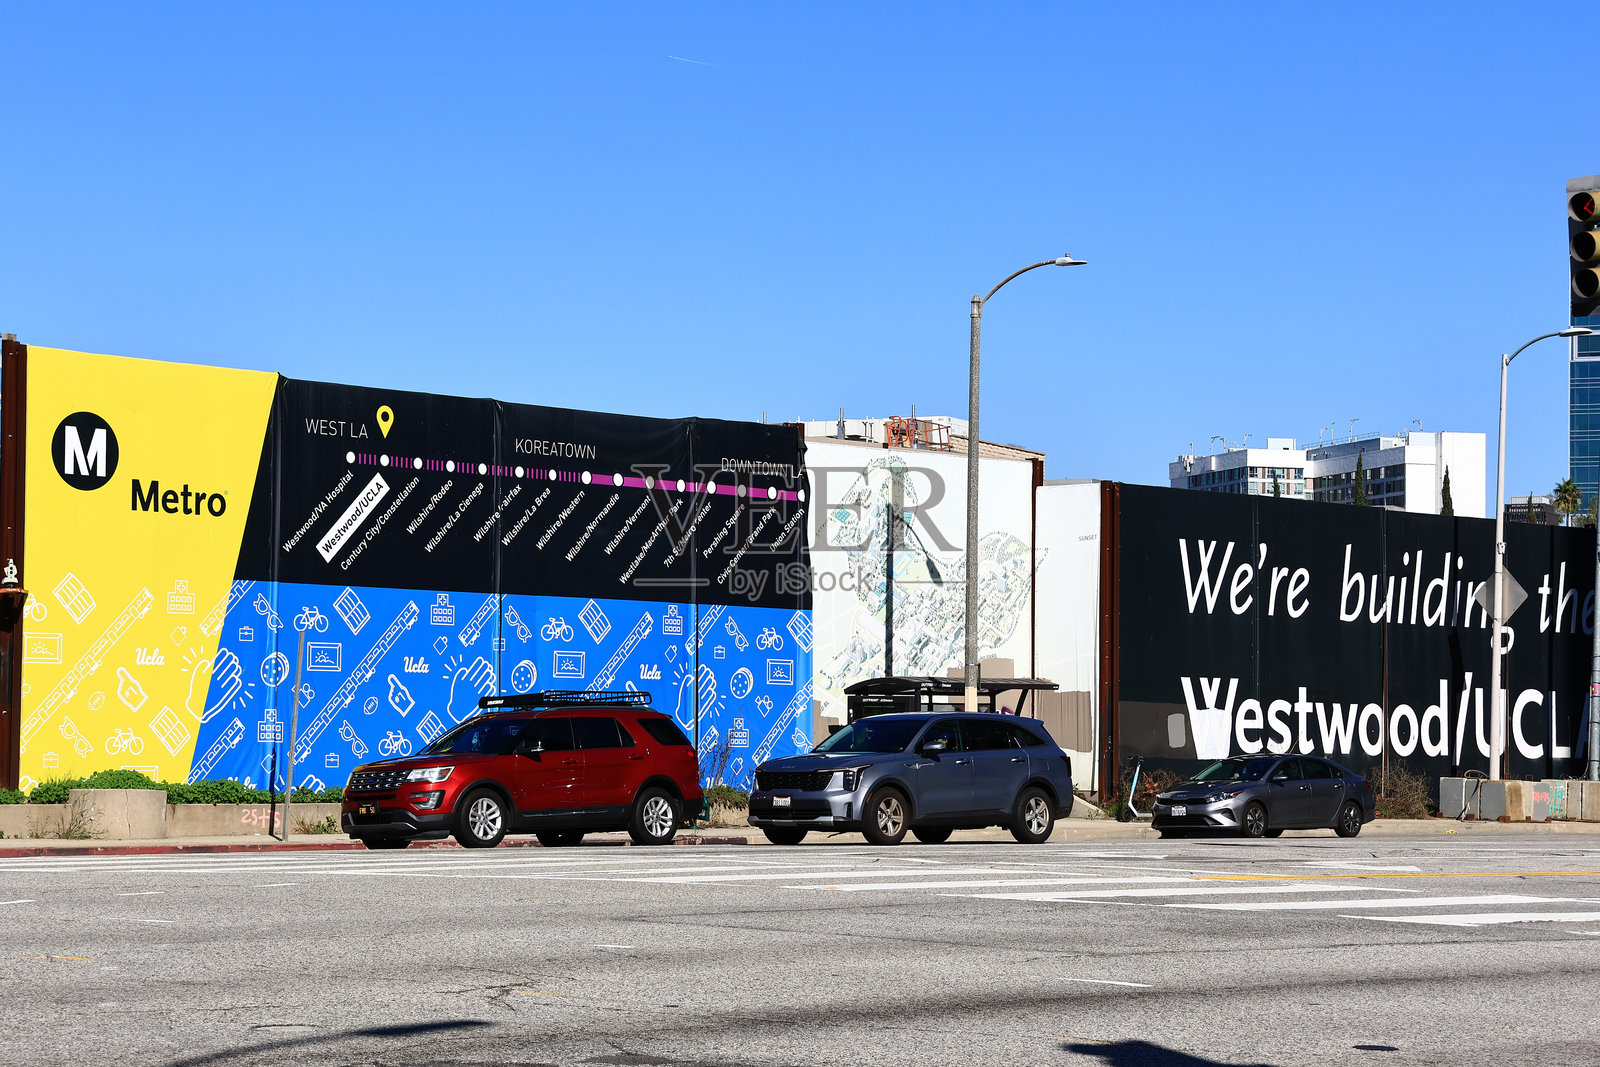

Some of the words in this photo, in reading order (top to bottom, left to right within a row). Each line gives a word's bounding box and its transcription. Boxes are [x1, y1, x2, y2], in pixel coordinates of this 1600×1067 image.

[64, 425, 107, 477] M
[305, 417, 347, 437] WEST
[350, 422, 369, 439] LA
[515, 438, 597, 460] KOREATOWN
[721, 457, 788, 477] DOWNTOWN
[131, 478, 227, 517] Metro
[282, 501, 329, 553] Westwood/VA
[325, 469, 354, 503] Hospital
[321, 481, 384, 554] Westwood/UCLA
[340, 539, 368, 571] Century
[365, 476, 420, 541] City/Constellation
[406, 479, 453, 535] Wilshire/Rodeo
[424, 511, 461, 553] Wilshire/La
[458, 482, 485, 512] Cienega
[501, 505, 537, 546] Wilshire/La
[534, 487, 551, 507] Brea
[536, 490, 586, 551] Wilshire/Western
[603, 494, 652, 555] Wilshire/Vermont
[565, 493, 620, 562] Wilshire/Normandie
[619, 514, 670, 584] Westlake/MacArthur
[668, 498, 684, 517] Park
[702, 527, 729, 559] Pershing
[725, 503, 746, 529] Square
[717, 565, 733, 584] Civic
[729, 520, 765, 568] Center/Grand
[761, 505, 777, 524] Park
[769, 531, 787, 552] Union
[783, 508, 805, 534] Station
[663, 554, 676, 569] 7th
[1179, 538, 1310, 619] We're
[135, 647, 166, 666] Ucla
[403, 656, 430, 673] Ucla
[640, 663, 662, 680] Ucla
